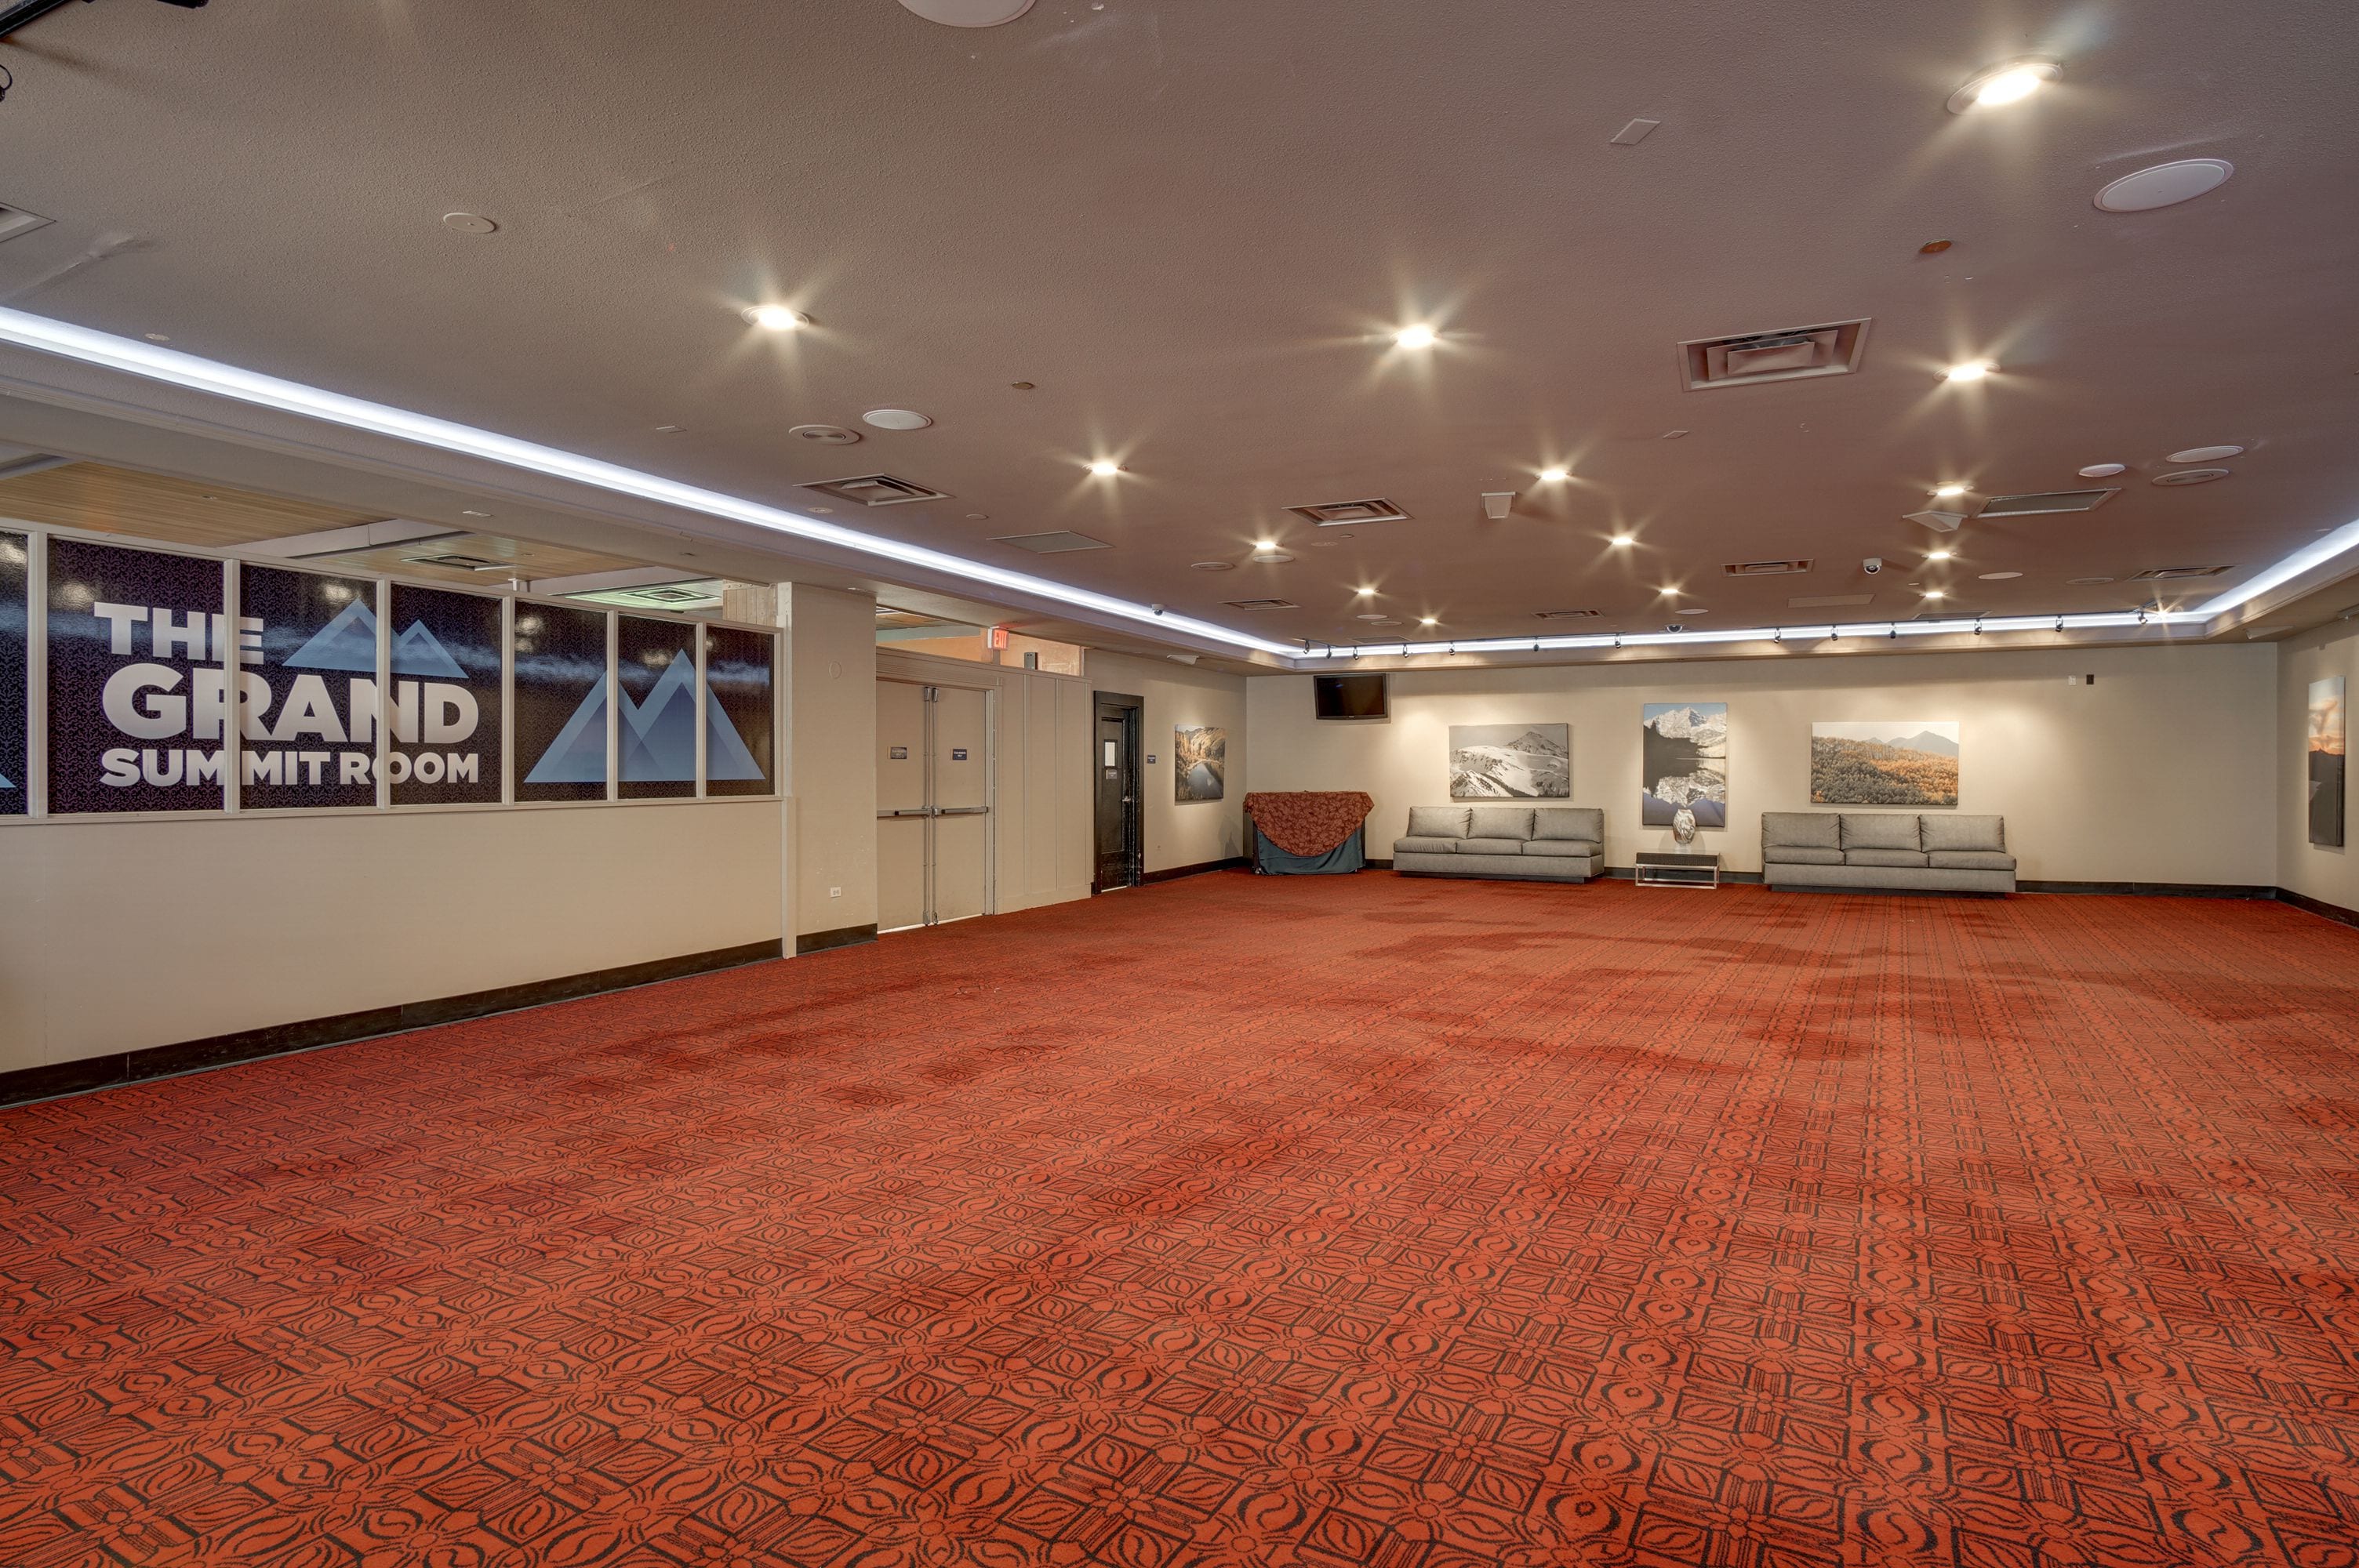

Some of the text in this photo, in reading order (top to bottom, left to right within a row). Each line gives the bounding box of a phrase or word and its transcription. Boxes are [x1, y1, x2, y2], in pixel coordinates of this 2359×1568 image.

[94, 601, 264, 665] THE
[994, 630, 1007, 649] EXIT
[102, 662, 479, 743] GRAND
[99, 748, 478, 787] SUMMIT ROOM
